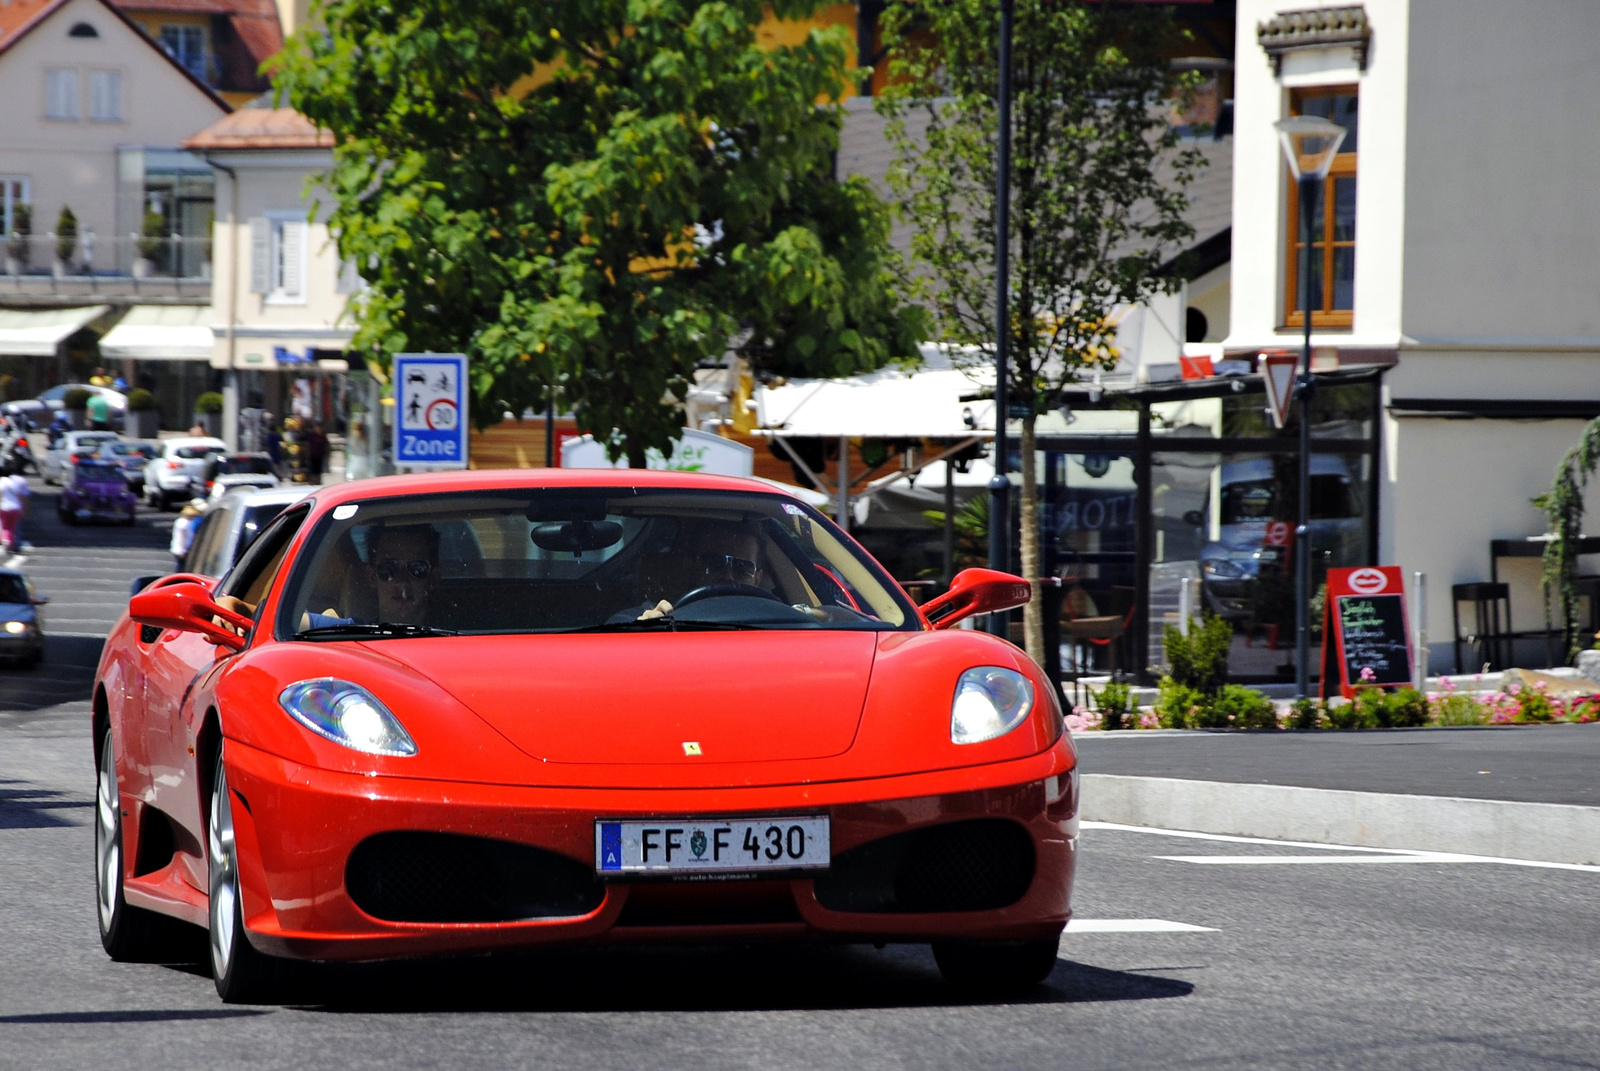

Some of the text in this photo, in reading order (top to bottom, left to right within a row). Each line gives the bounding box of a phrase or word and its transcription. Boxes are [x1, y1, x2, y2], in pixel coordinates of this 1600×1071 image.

[434, 407, 453, 425] 30
[403, 435, 456, 455] Zone
[641, 825, 805, 862] FF F 430
[607, 852, 616, 863] A
